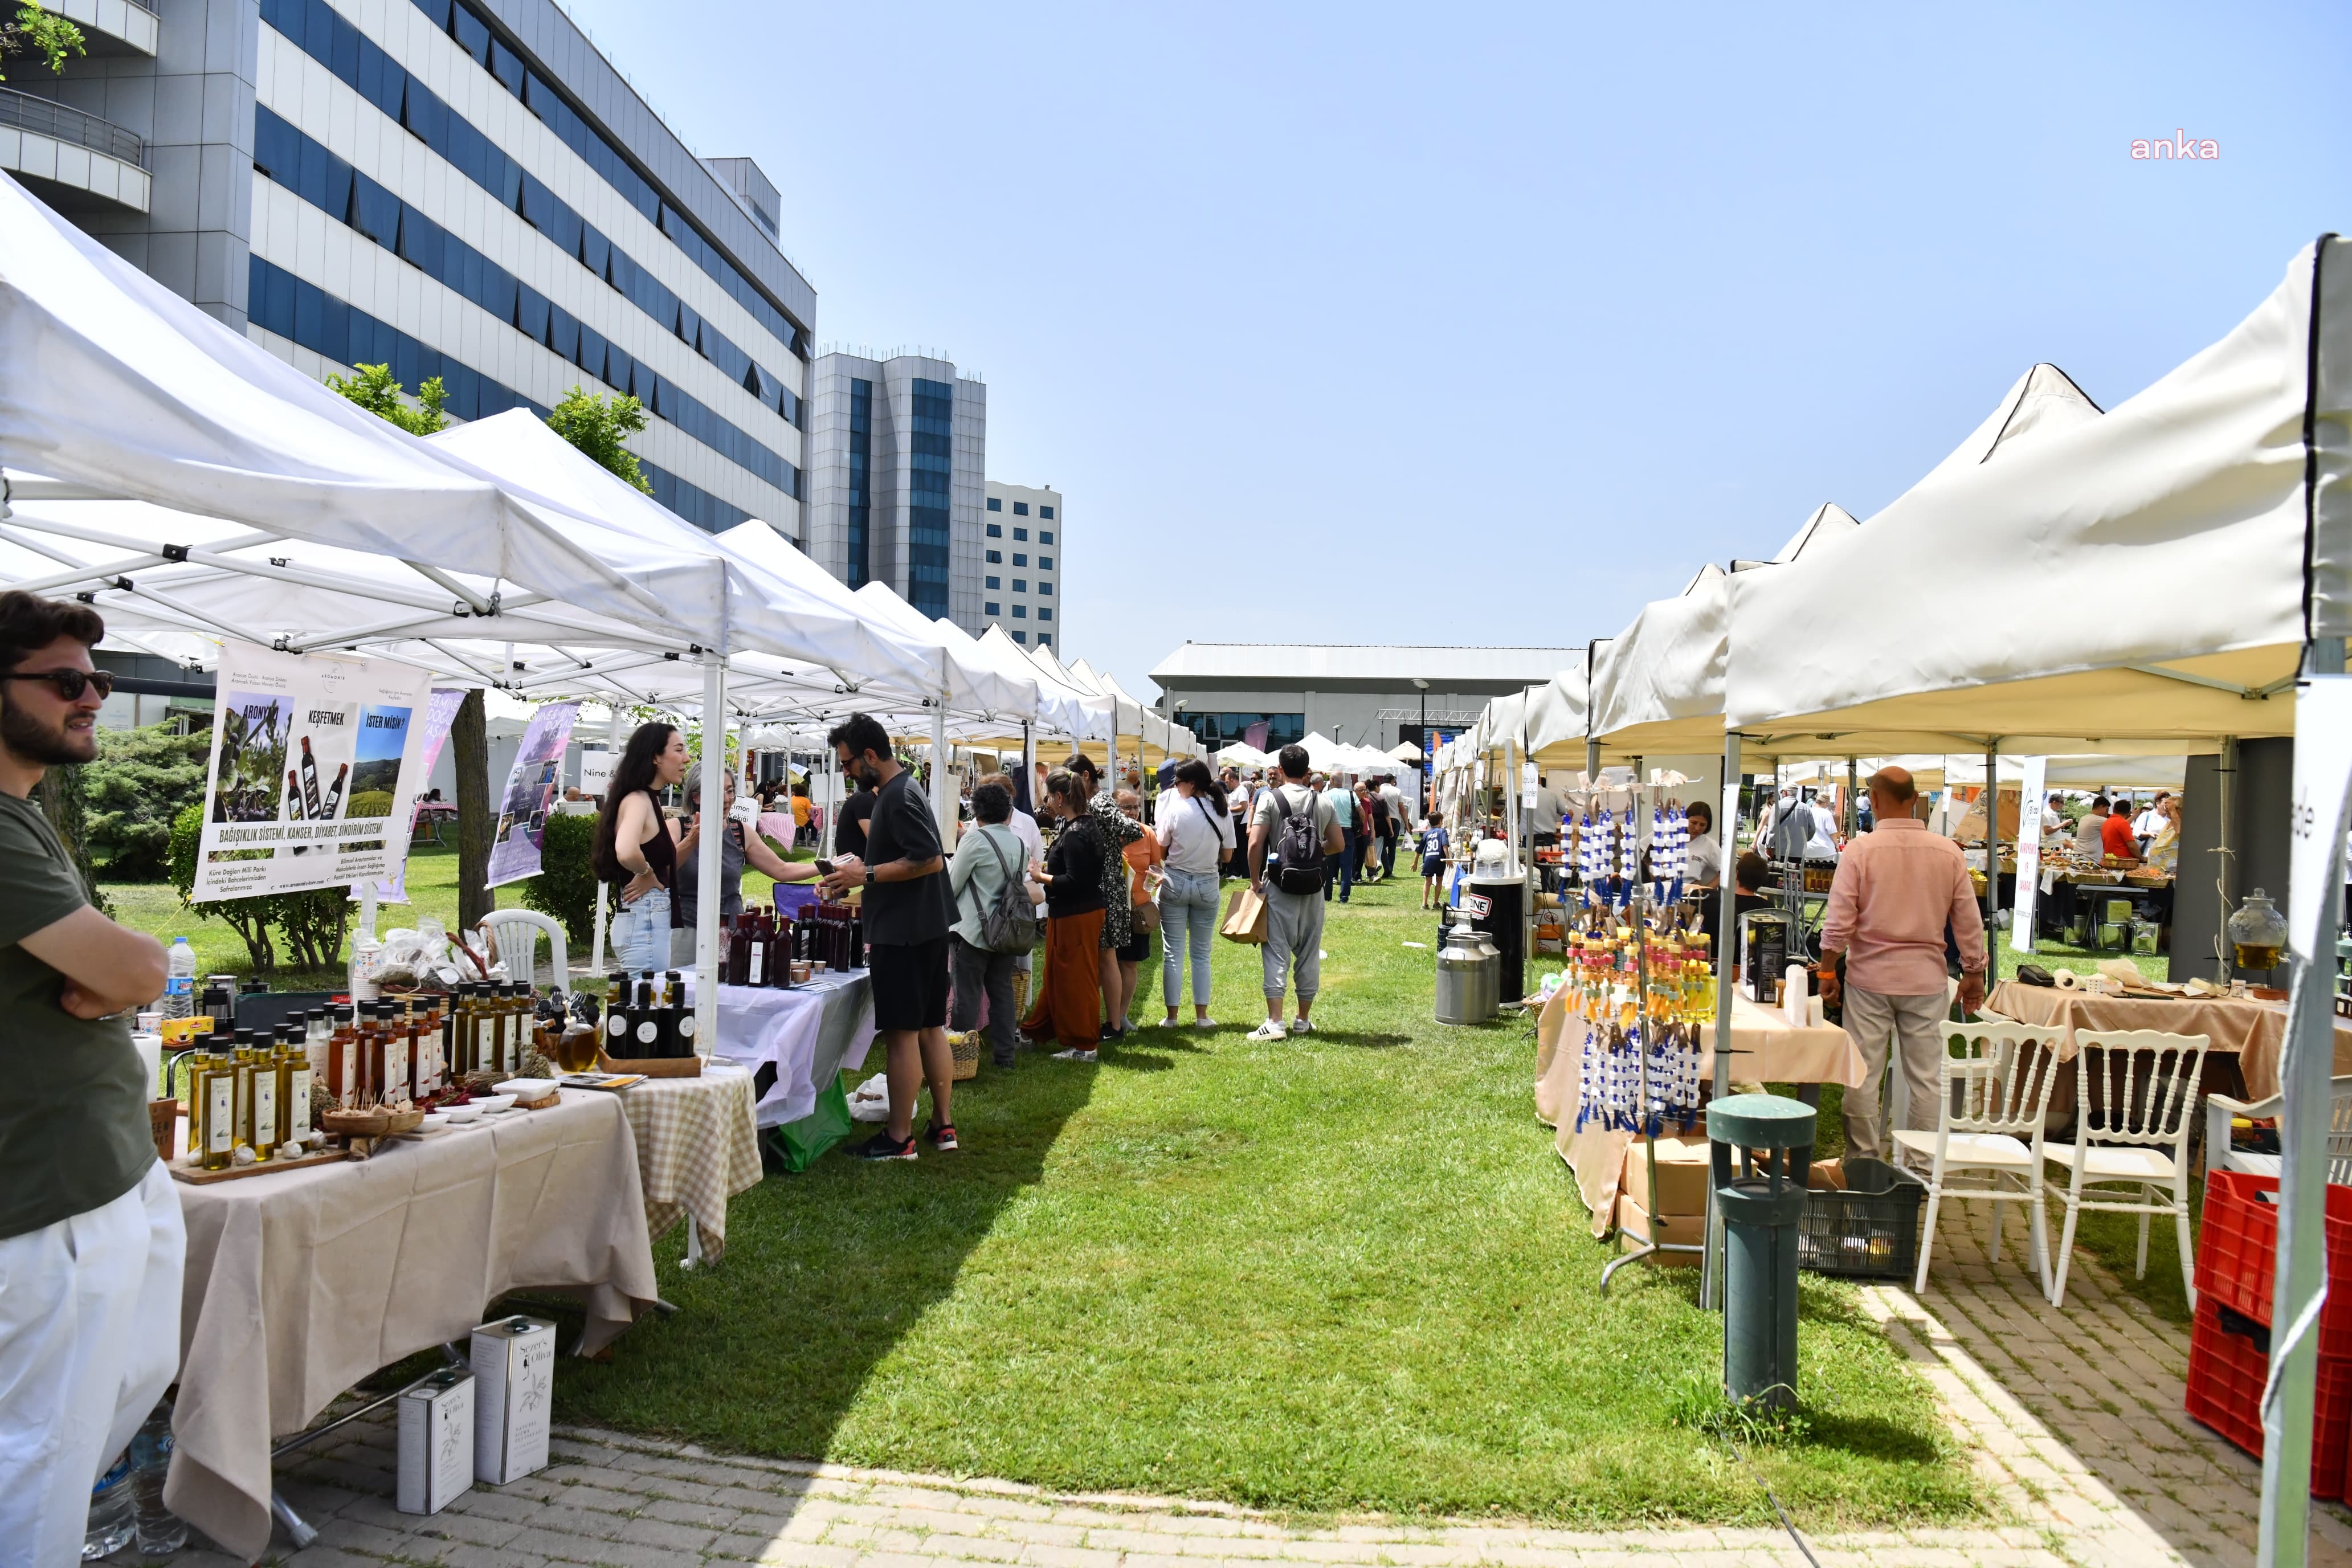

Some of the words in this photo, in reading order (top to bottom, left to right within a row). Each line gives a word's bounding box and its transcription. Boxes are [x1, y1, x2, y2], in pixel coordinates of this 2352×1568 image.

[308, 710, 345, 728] KEŞFETMEK
[366, 713, 382, 728] İSTER
[219, 827, 258, 846] BAĞIŞIKLIK
[259, 825, 286, 842] SİSTEMİ,
[287, 827, 314, 840] KANSER,
[315, 824, 338, 838] DİYABET,
[338, 822, 363, 836] SİNDİRİM
[364, 820, 384, 835] SİSTEMİ
[1427, 839, 1438, 851] 30
[228, 874, 266, 884] Bahçelerimizden
[220, 884, 252, 893] Sofralarımıza
[520, 1338, 548, 1355] Sezer's
[531, 1350, 552, 1363] Oliva
